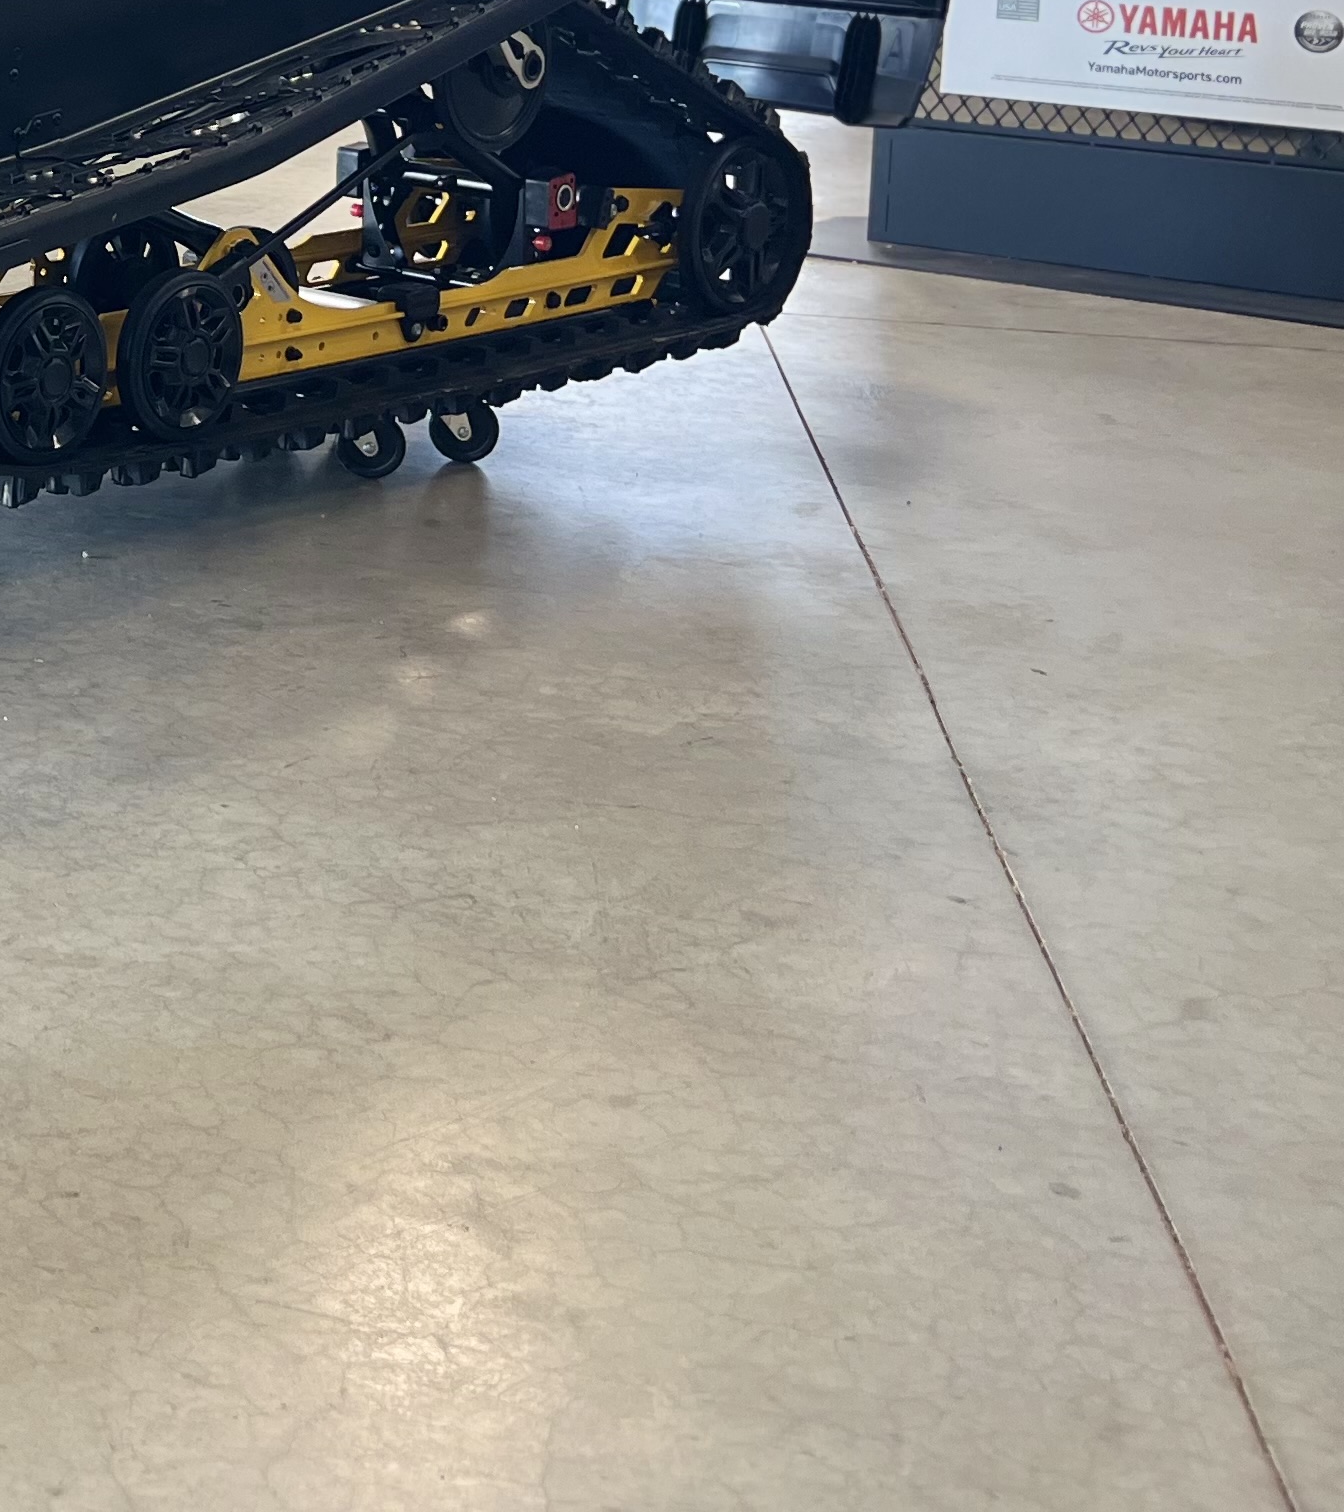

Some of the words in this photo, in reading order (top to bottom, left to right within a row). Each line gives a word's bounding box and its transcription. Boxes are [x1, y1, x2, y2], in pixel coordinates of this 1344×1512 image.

[1119, 3, 1258, 44] YAMAHA
[1103, 40, 1160, 56] Revs
[1158, 44, 1200, 58] Your
[1198, 46, 1245, 57] Heart
[1088, 61, 1243, 85] YamahaMotorsports.com
